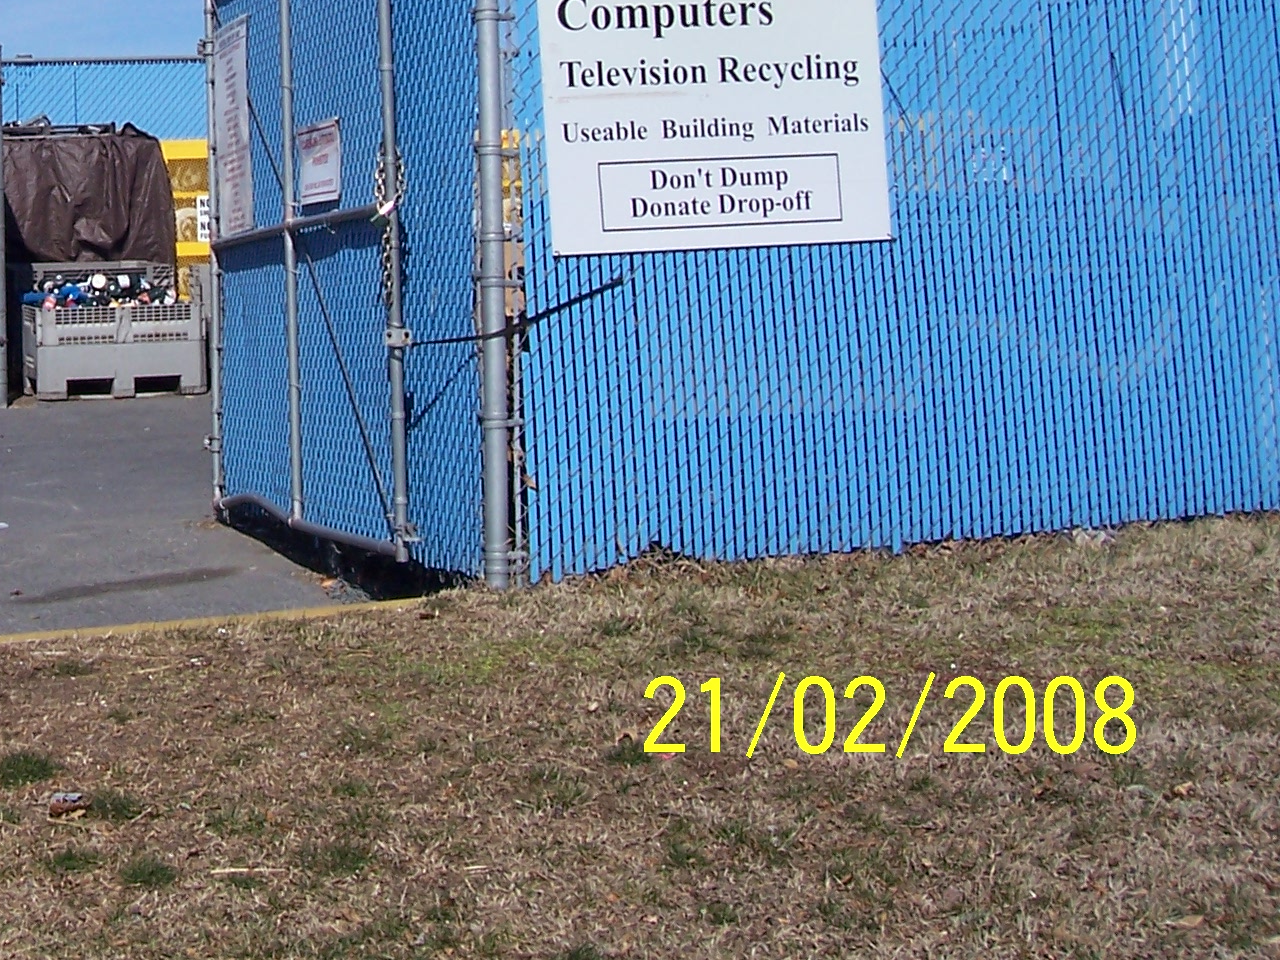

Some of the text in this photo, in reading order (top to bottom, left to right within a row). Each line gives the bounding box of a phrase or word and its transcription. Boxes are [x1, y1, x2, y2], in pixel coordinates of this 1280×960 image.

[559, 53, 860, 89] Television Recycling
[561, 112, 869, 144] Useable Building Materials
[650, 166, 789, 191] Don't Dump
[631, 190, 814, 219] Donate Drop-off
